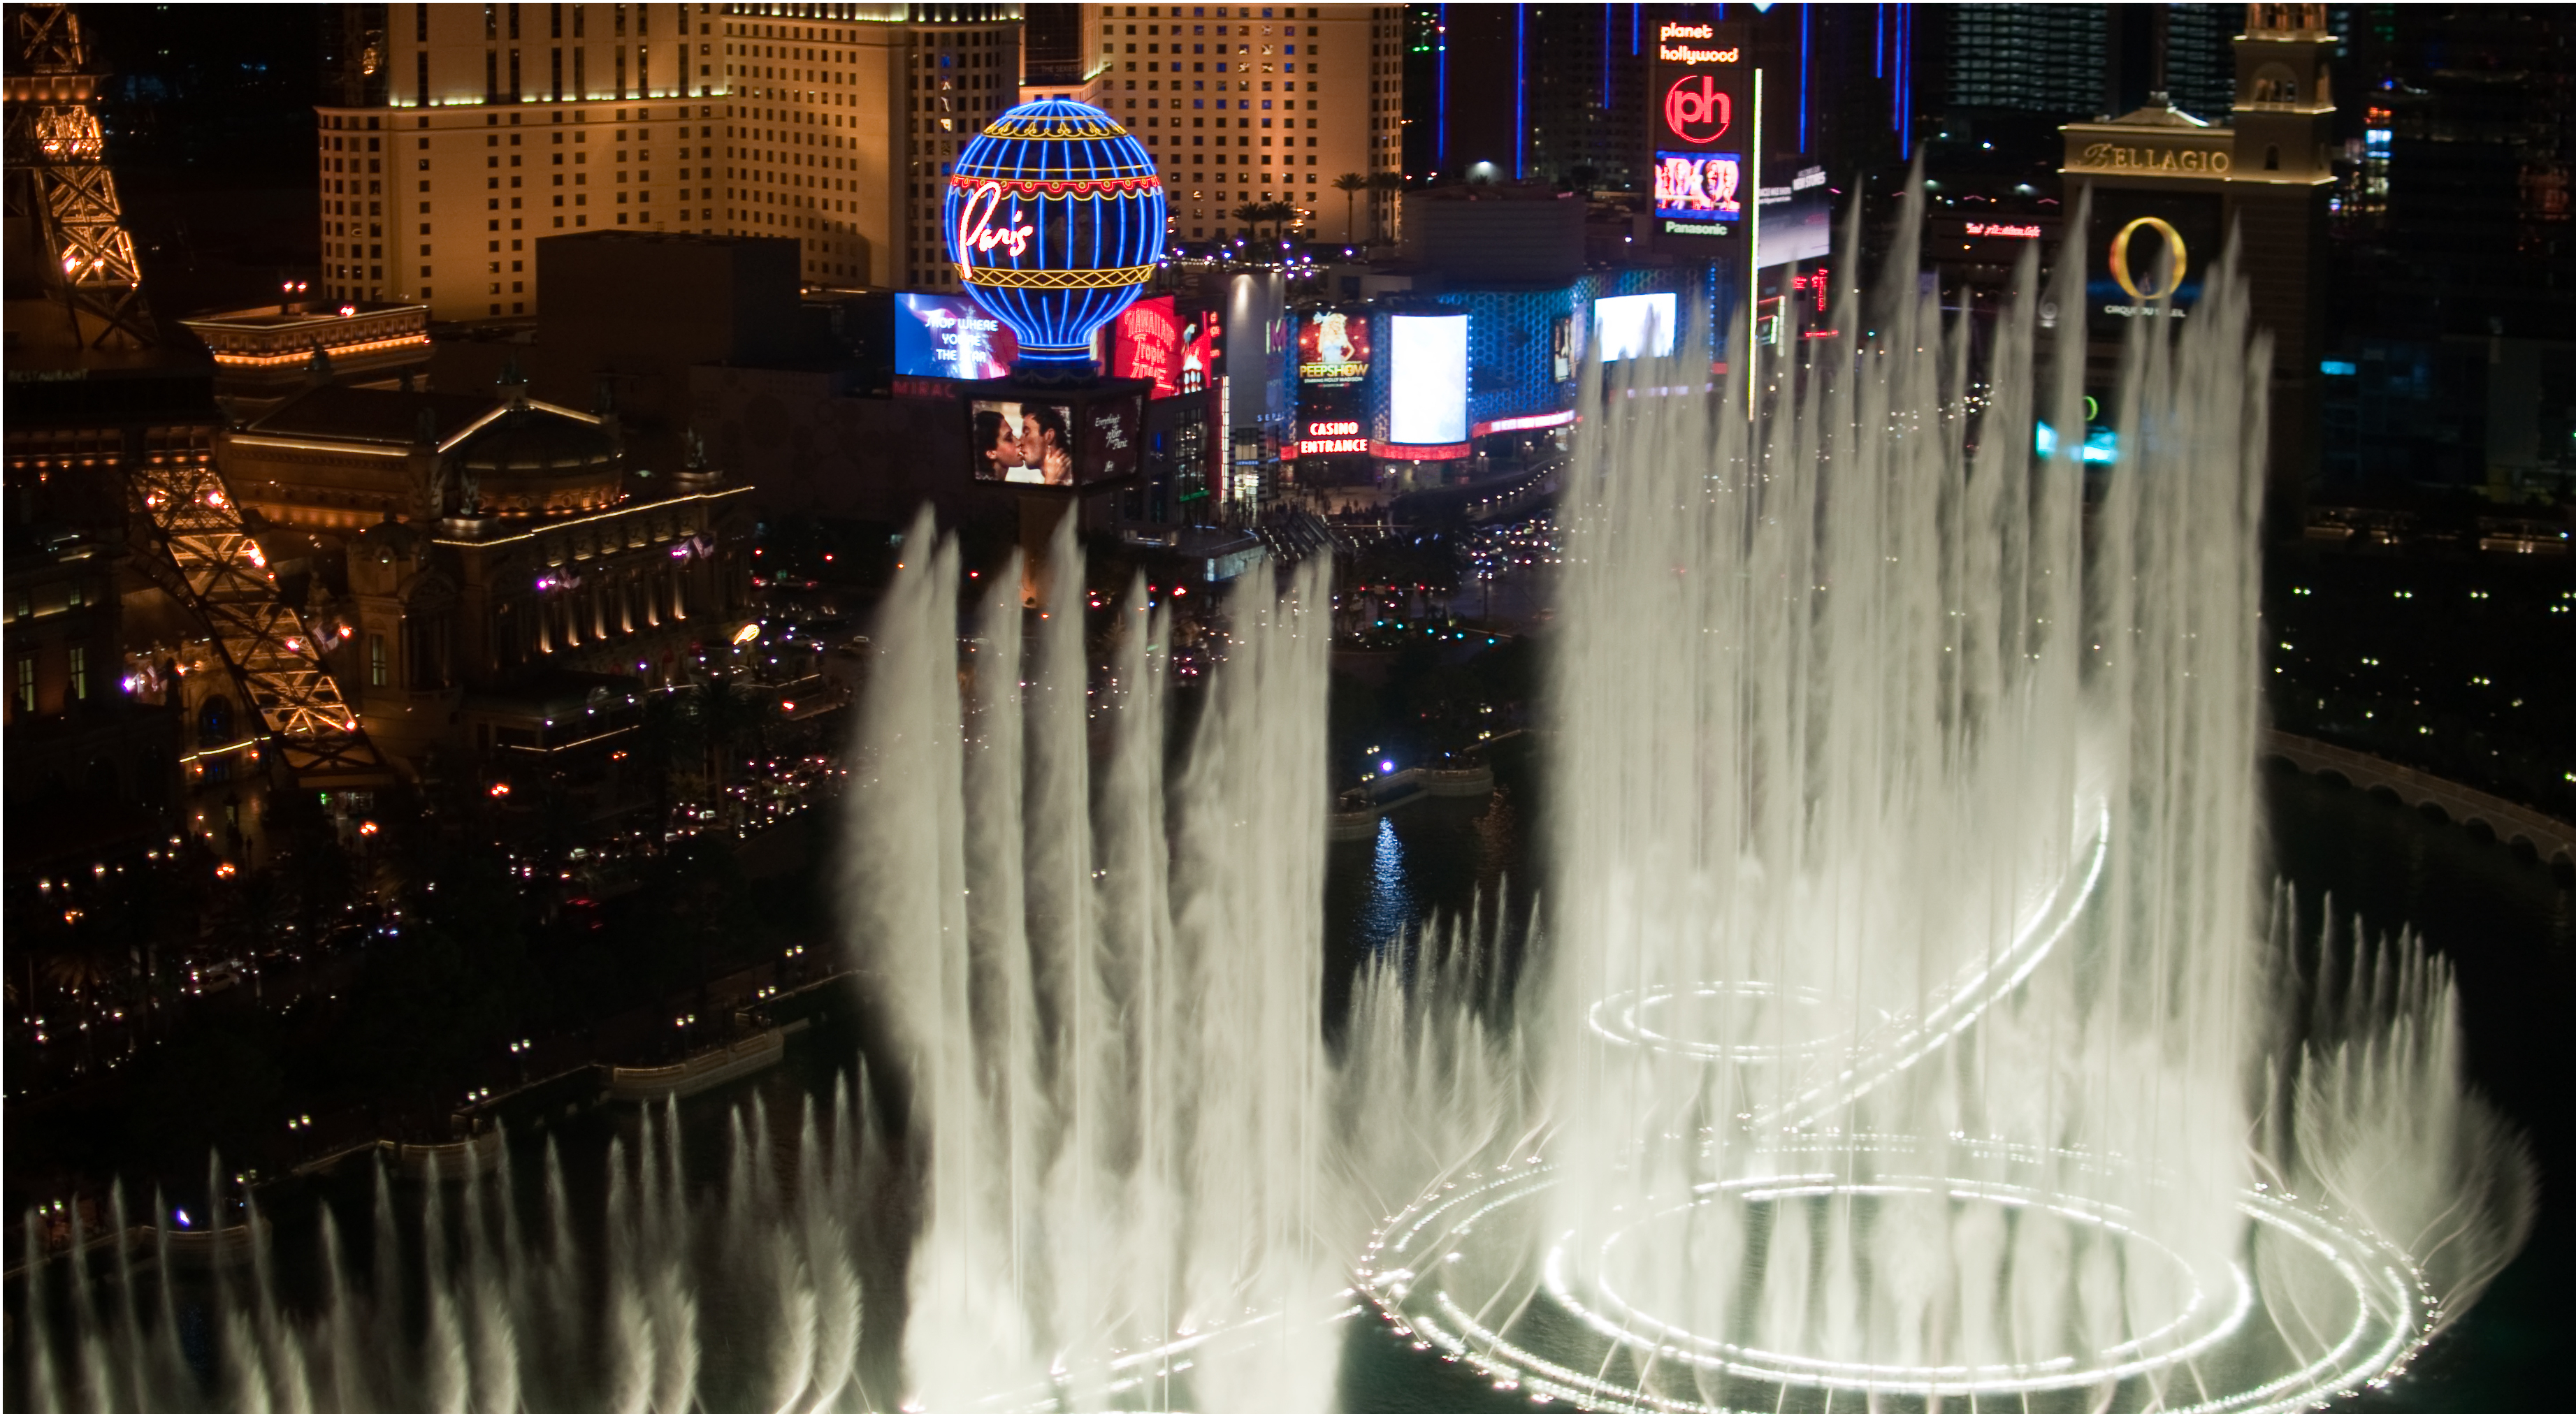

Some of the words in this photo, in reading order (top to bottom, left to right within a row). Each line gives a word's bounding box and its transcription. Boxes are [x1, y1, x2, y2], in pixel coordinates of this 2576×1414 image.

[1660, 22, 1714, 41] planet
[1660, 45, 1739, 66] hollywood
[1674, 75, 1731, 133] ph
[2078, 143, 2229, 173] BELLAGIO
[960, 181, 1034, 279] Paris
[1665, 221, 1728, 236] Panasonic
[2109, 217, 2187, 300] O
[925, 316, 955, 329] SHOP
[957, 318, 999, 332] WHERE
[1124, 308, 1176, 353] HAWAIIAN
[936, 349, 957, 361] THE
[1134, 333, 1166, 366] Tropic
[1299, 363, 1369, 378] PEEPSHOW
[1309, 421, 1359, 437] CASINO
[1300, 438, 1368, 454] ENTRANCE
